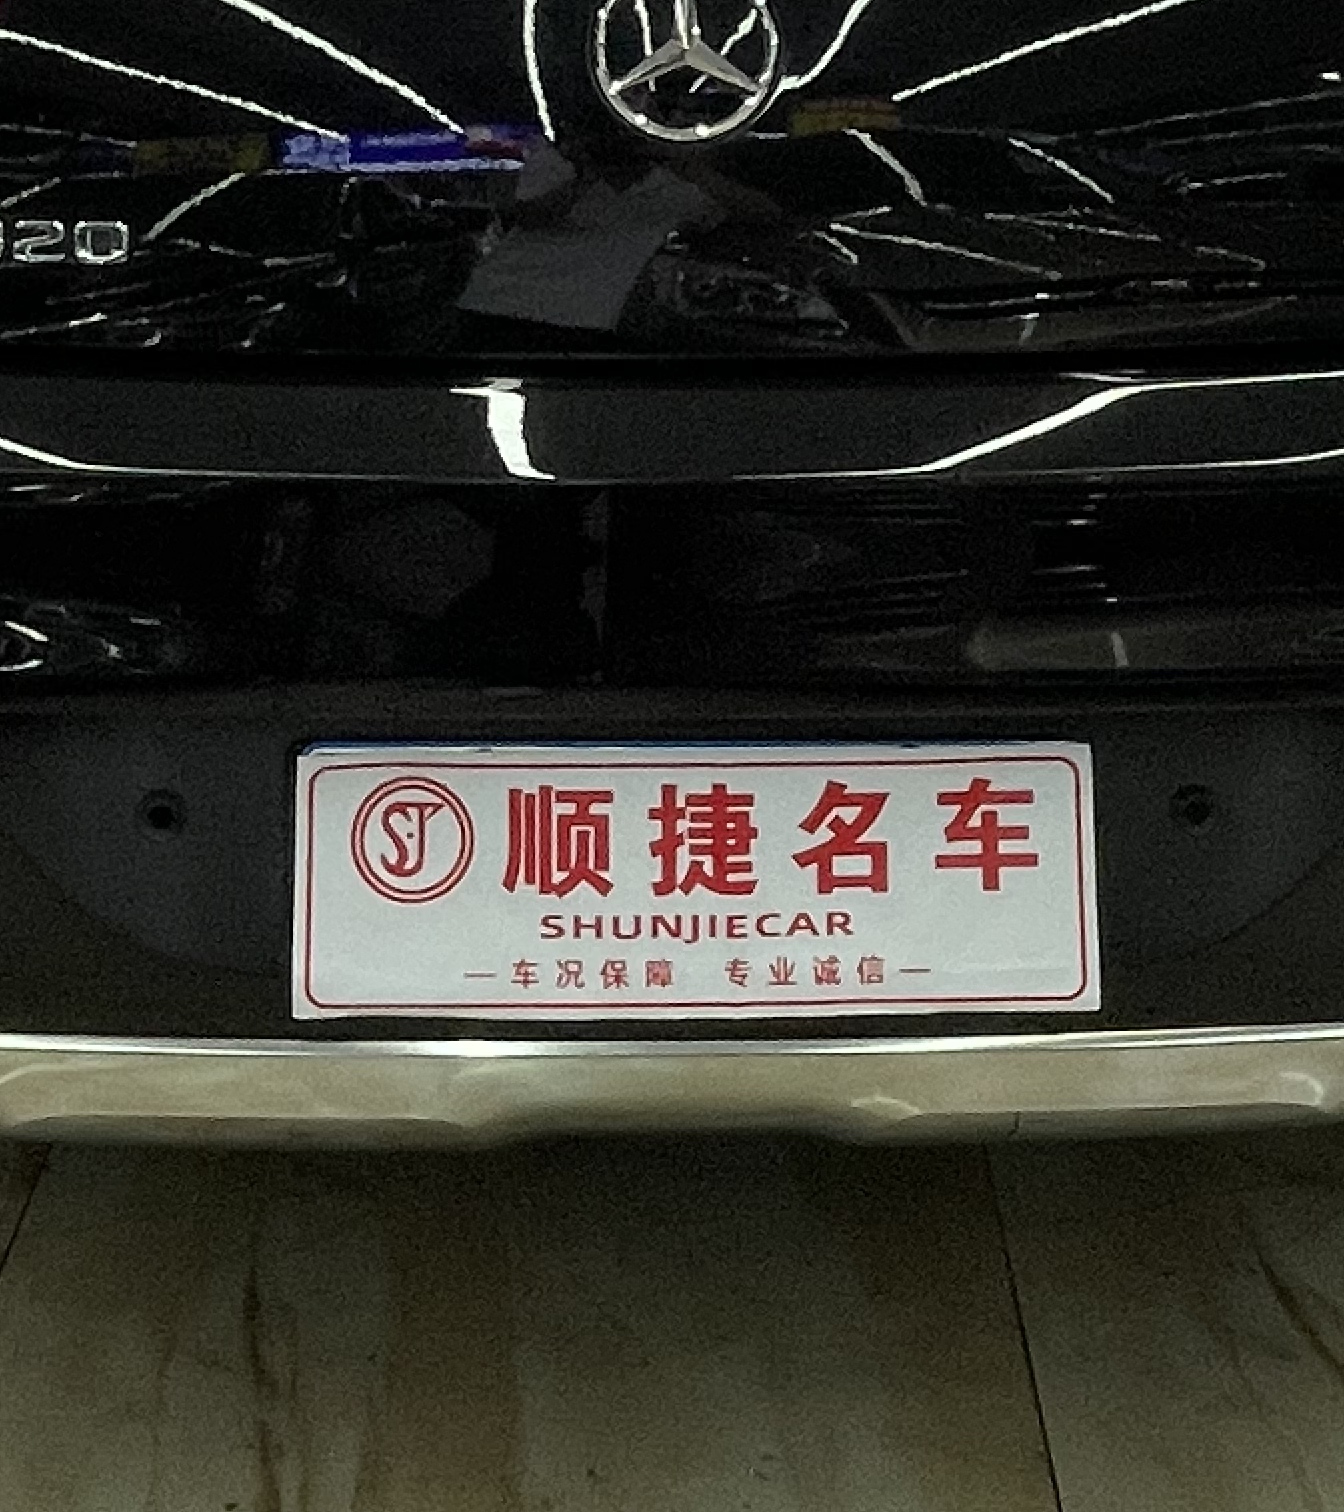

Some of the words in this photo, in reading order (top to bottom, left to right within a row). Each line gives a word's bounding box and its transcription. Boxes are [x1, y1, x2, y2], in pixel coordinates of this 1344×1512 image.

[502, 777, 1040, 898] 顺捷名车
[539, 910, 854, 944] SHUNJIECAR
